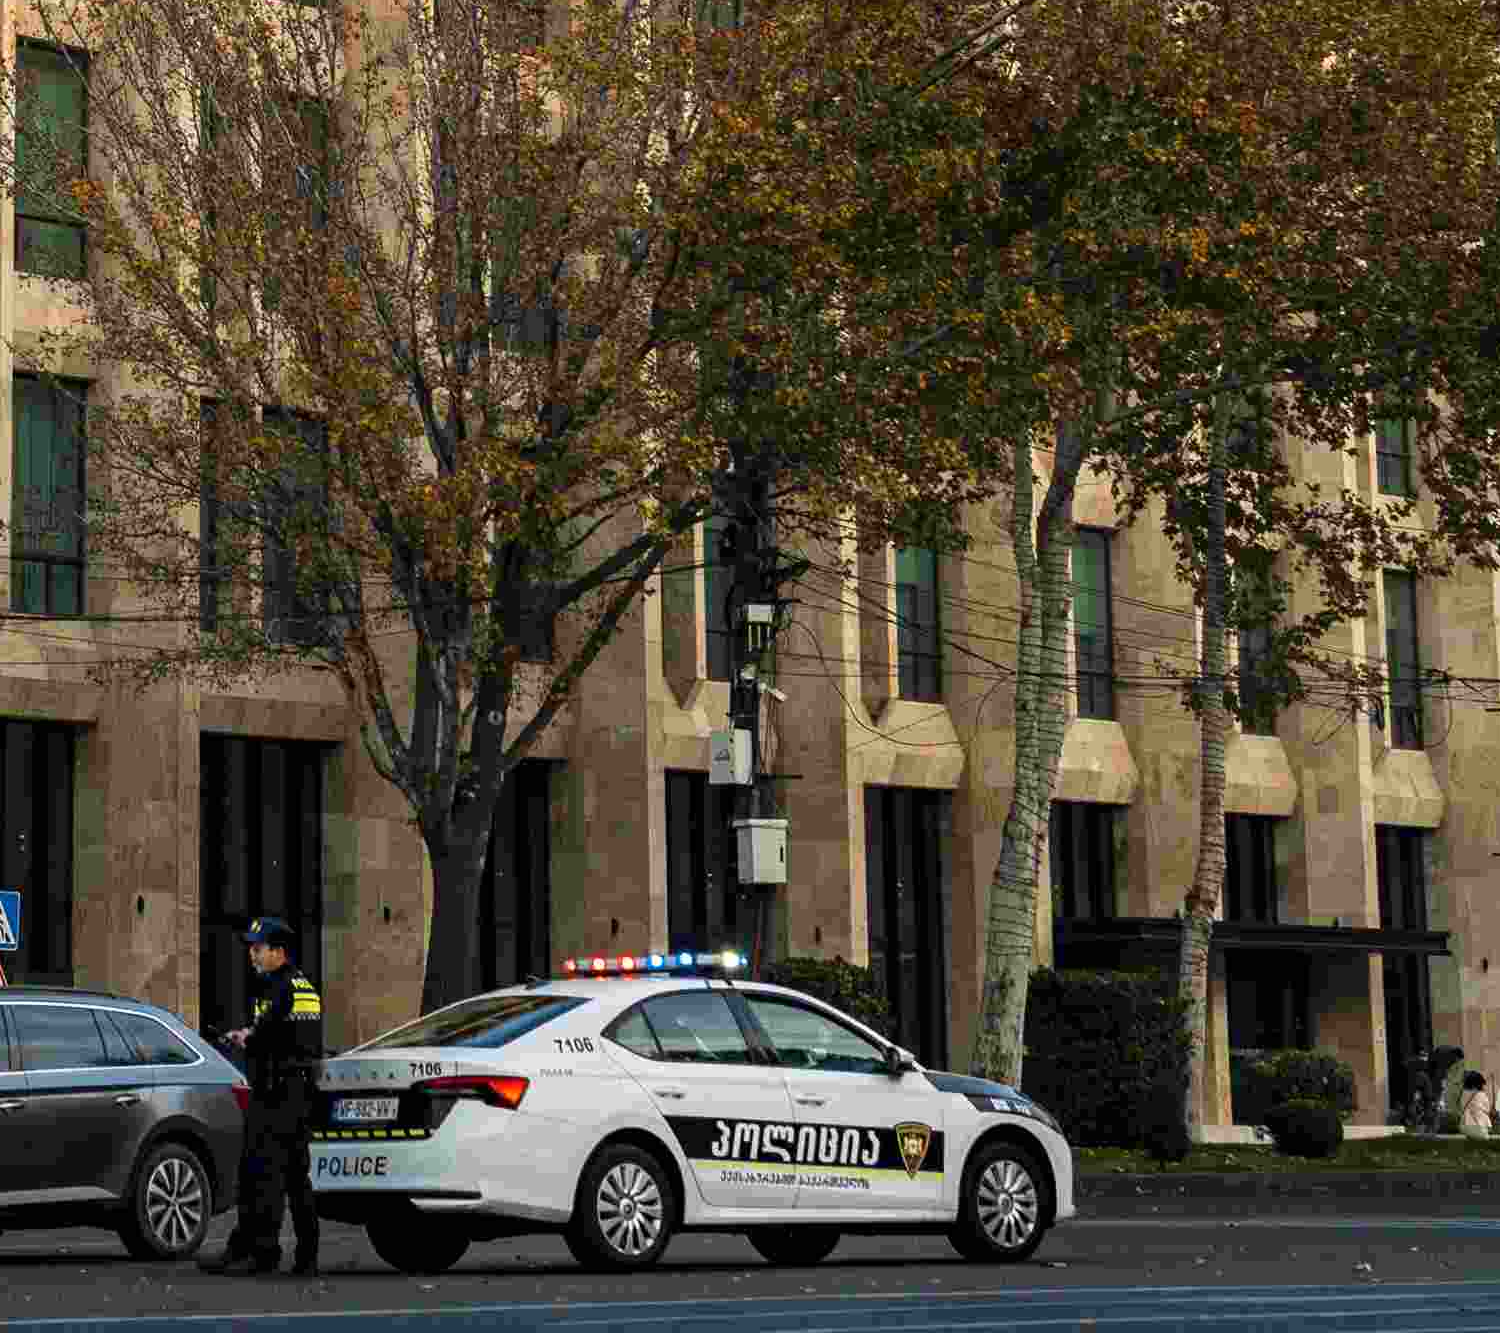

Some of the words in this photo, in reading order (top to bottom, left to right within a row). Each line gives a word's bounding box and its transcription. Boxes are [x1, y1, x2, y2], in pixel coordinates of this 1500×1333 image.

[554, 1036, 594, 1053] 7106
[409, 1062, 442, 1077] 7106
[711, 1119, 881, 1166] პოლიცია
[316, 1156, 388, 1177] POLICE
